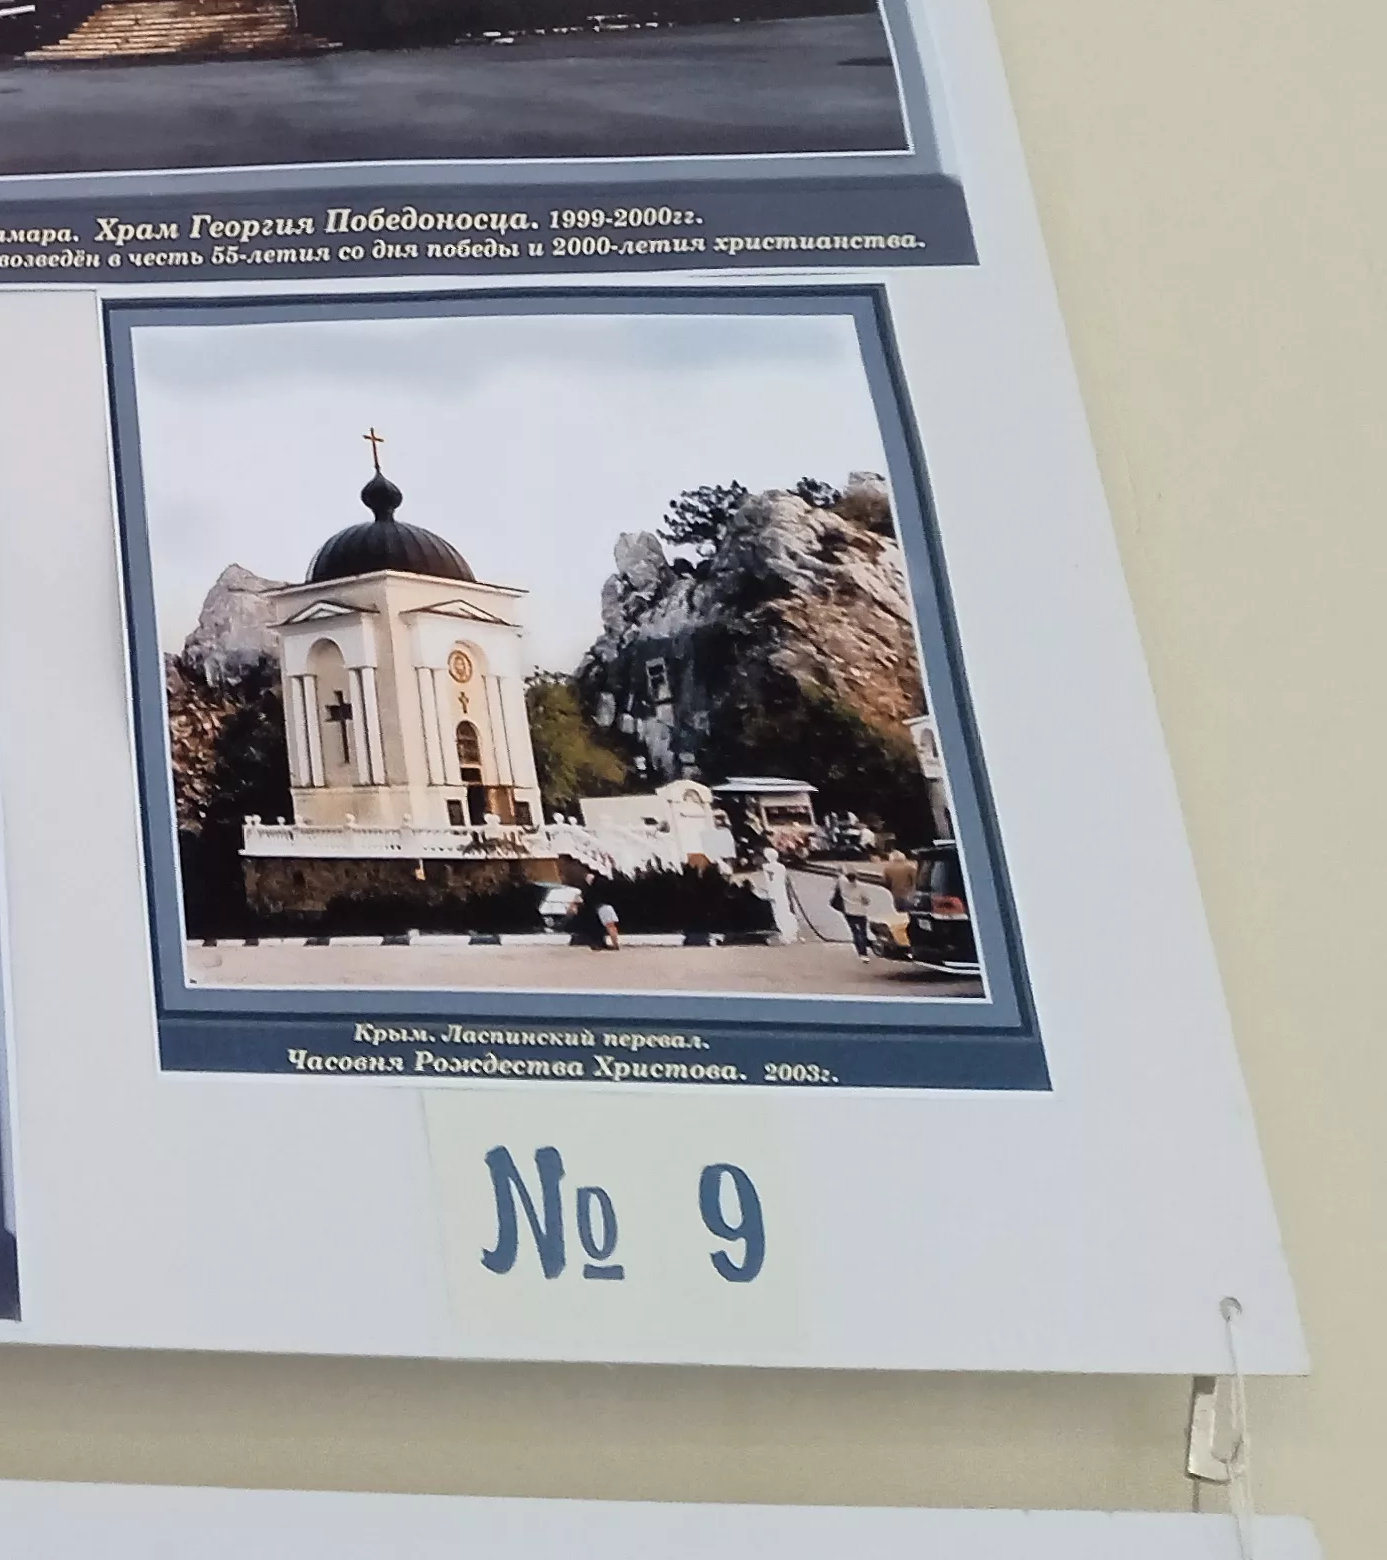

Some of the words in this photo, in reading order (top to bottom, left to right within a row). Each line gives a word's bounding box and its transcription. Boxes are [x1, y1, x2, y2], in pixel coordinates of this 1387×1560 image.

[95, 217, 178, 245] Храм
[189, 214, 314, 239] Георгия
[325, 207, 539, 236] Победоносца.
[548, 207, 703, 229] 1999-2000гг.
[108, 254, 122, 267] в
[128, 249, 204, 267] честь
[211, 243, 331, 264] 55-летия
[339, 246, 363, 260] со
[371, 239, 418, 261] дня
[427, 237, 520, 260] победы
[528, 242, 544, 258] и
[552, 235, 706, 257] 2000-летия
[714, 231, 926, 255] христианства.
[353, 1023, 435, 1045] Крым.
[441, 1025, 595, 1048] Ласпинский
[603, 1033, 710, 1053] перевал.
[286, 1048, 404, 1073] Часовня
[414, 1050, 584, 1079] Рождества
[592, 1055, 747, 1083] Христова.
[764, 1062, 839, 1083] 2003г.
[698, 1162, 767, 1283] 9
